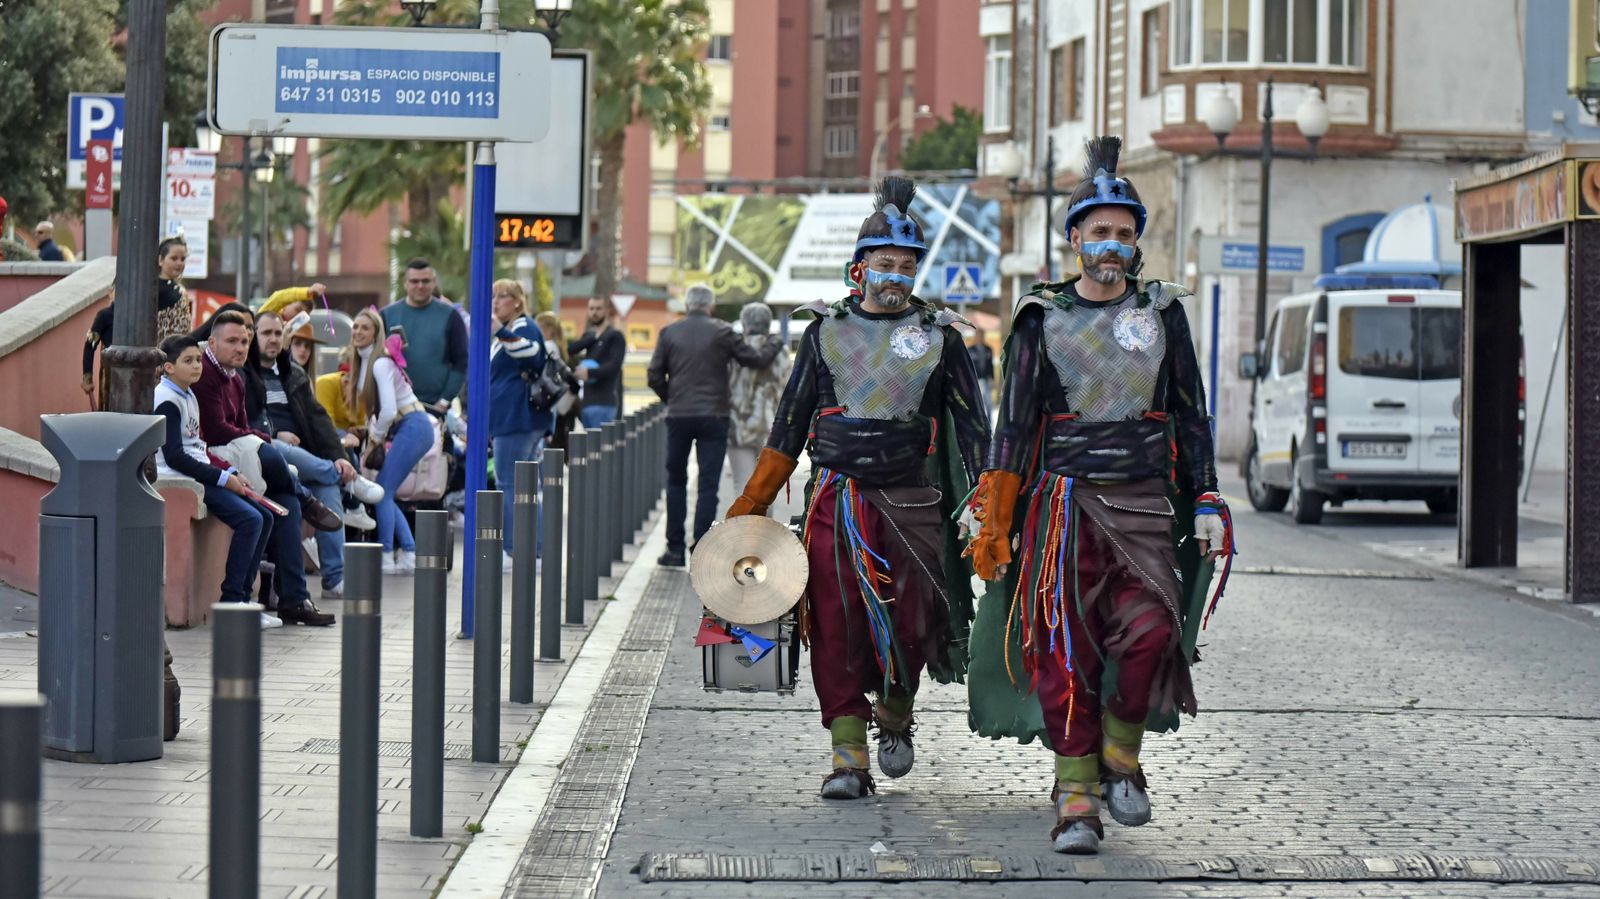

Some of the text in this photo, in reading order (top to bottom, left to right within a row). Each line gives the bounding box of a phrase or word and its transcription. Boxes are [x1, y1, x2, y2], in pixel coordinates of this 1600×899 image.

[281, 65, 495, 83] impursa ESPACIO DISPONIBLE
[281, 87, 494, 106] 647 31 0315 902 010 113
[80, 98, 115, 149] P
[500, 218, 554, 242] 17:42
